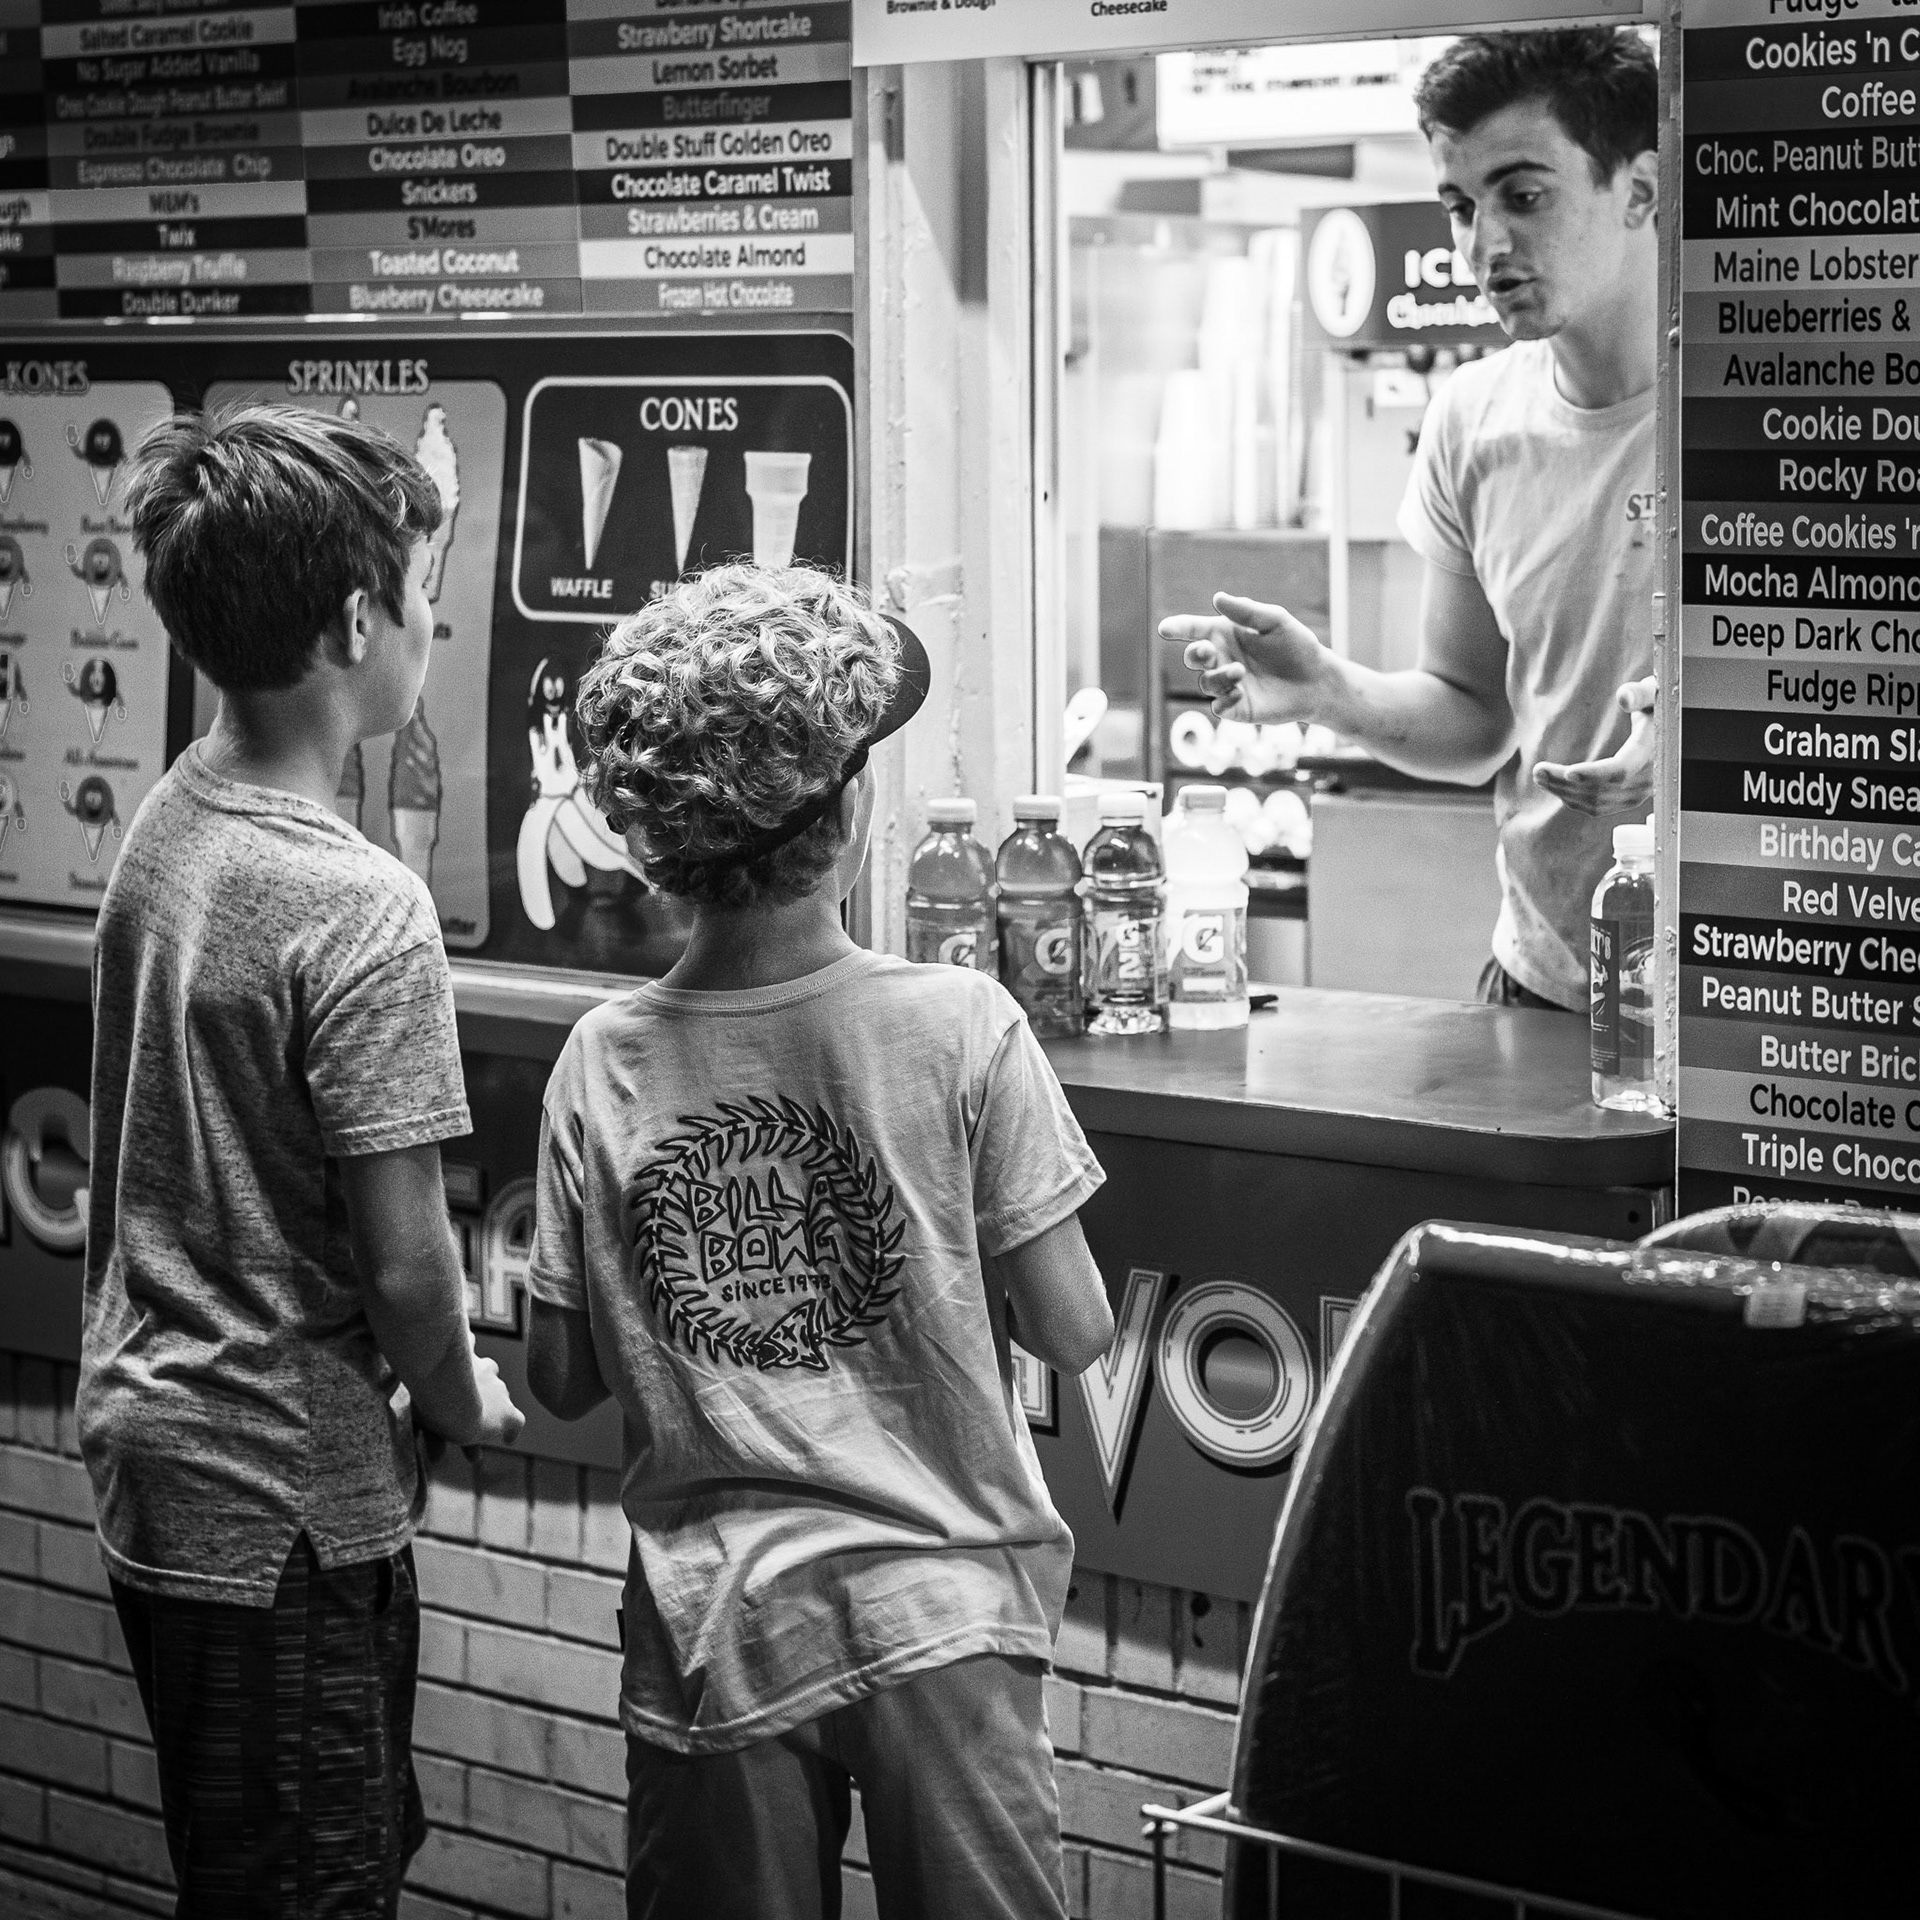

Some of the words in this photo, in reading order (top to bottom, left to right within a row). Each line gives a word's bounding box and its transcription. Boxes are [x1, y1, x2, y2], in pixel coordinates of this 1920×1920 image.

[378, 4, 417, 30] Irish
[420, 1, 478, 26] Coffee
[1091, 0, 1167, 17] Cheesecake
[618, 20, 717, 50] Strawberry
[720, 11, 812, 43] Shortcake
[77, 61, 100, 82] No
[102, 58, 146, 86] Sugar
[150, 53, 203, 78] Added
[205, 49, 260, 74] Vanilla
[392, 37, 427, 67] Egg
[430, 34, 468, 63] Nog
[1746, 31, 1857, 70] Cookies
[1866, 30, 1890, 63] 'n
[652, 59, 714, 84] Lemon
[718, 54, 778, 80] Sorbet
[662, 91, 771, 121] Butterfinger
[1822, 82, 1916, 118] Coffee
[367, 111, 417, 136] Dulce
[421, 110, 445, 134] De
[450, 106, 501, 132] Leche
[369, 144, 458, 172] Chocolate
[460, 143, 507, 168] Oreo
[606, 131, 669, 161] Double
[673, 130, 716, 158] Stuff
[720, 129, 784, 156] Golden
[788, 128, 832, 154] Oreo
[1696, 141, 1764, 175] Choc.
[1773, 138, 1863, 173] Peanut
[146, 155, 226, 181] Chocolate
[233, 152, 272, 180] Chip
[611, 169, 701, 199] Chocolate
[704, 165, 779, 196] Caramel
[782, 164, 831, 192] Twist
[401, 178, 478, 206] Snickers
[408, 215, 477, 240] S'Mores
[628, 203, 740, 235] Strawberries
[743, 203, 757, 232] &
[759, 203, 819, 231] Cream
[1717, 194, 1779, 228] Mint
[157, 223, 197, 248] Twix
[369, 249, 441, 276] Toasted
[442, 249, 520, 274] Coconut
[644, 243, 732, 269] Chocolate
[737, 241, 806, 267] Almond
[1714, 248, 1799, 283] Maine
[1810, 246, 1919, 281] Lobster
[350, 283, 436, 315] Blueberry
[437, 281, 545, 308] Cheesecake
[658, 280, 702, 308] Frozen
[703, 280, 728, 307] Hot
[729, 279, 795, 307] Chocolate
[1718, 297, 1882, 334] Blueberries
[1892, 299, 1911, 332] &
[287, 360, 430, 395] SPRINKLES
[1723, 351, 1875, 386] Avalanche
[640, 396, 739, 431] CONES
[1763, 405, 1862, 440] Cookie
[1780, 457, 1867, 500] Rocky
[1701, 512, 1784, 547] Coffee
[1792, 514, 1896, 550] Cookies
[551, 576, 613, 599] WAFFLE
[1705, 563, 1798, 598] Mocha
[1713, 615, 1784, 656] Deep
[1795, 617, 1862, 651] Dark
[1768, 669, 1856, 711] Fudge
[1764, 723, 1880, 760] Graham
[1744, 770, 1842, 815] Muddy
[1851, 777, 1920, 813] Snea
[1760, 823, 1884, 872] Birthday
[1784, 880, 1838, 916] Red
[1693, 923, 1851, 975] Strawberry
[1702, 976, 1802, 1016] Peanut
[1812, 986, 1903, 1025] Butter
[1761, 1035, 1852, 1074] Butter
[1750, 1083, 1896, 1129] Chocolate
[1742, 1133, 1824, 1176] Triple
